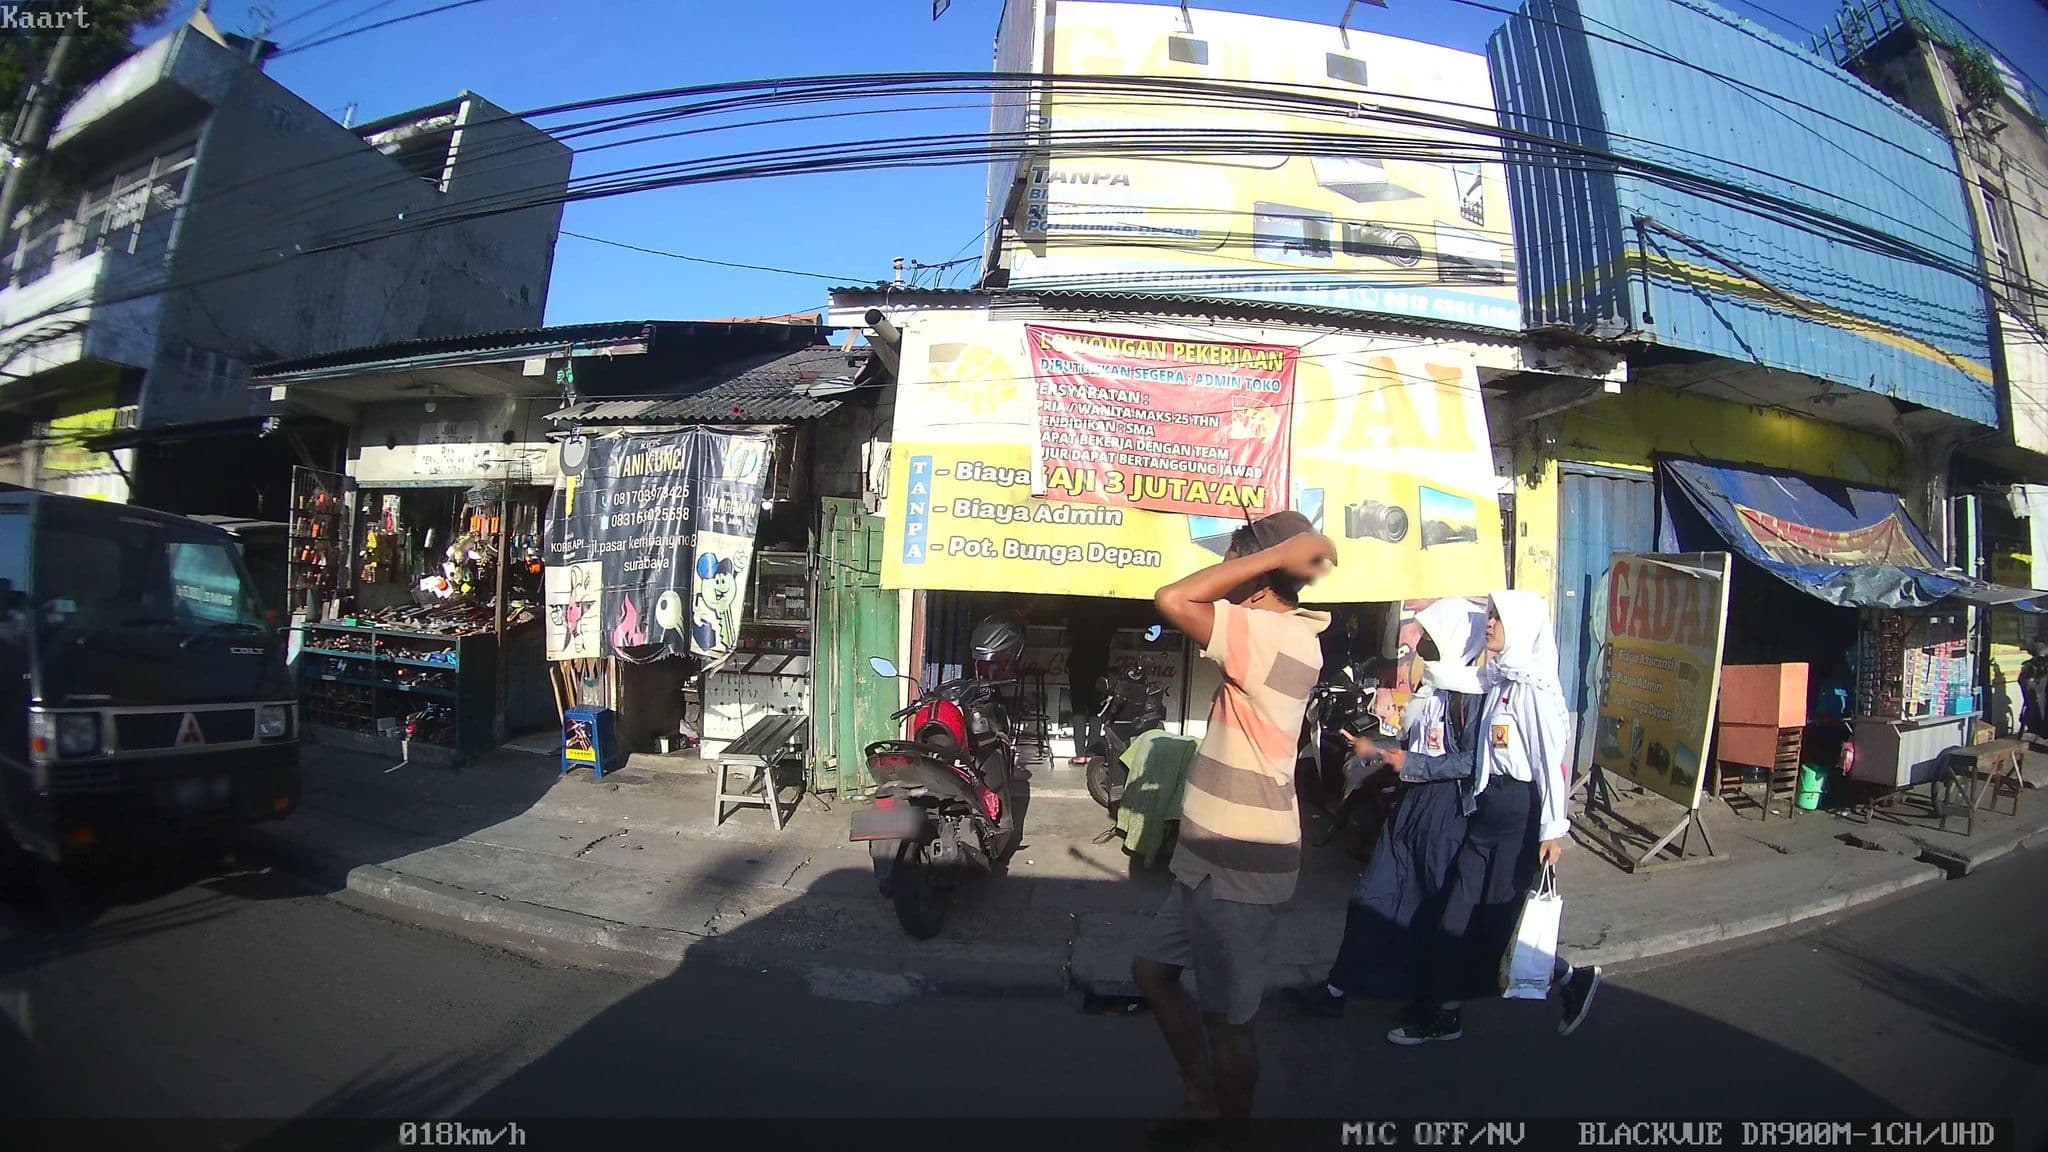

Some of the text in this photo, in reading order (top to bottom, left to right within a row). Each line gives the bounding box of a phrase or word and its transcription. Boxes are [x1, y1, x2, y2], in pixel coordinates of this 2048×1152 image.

[1030, 166, 1131, 187] TANPA
[1172, 343, 1284, 372] PEKERJAAN
[1037, 381, 1141, 404] ERSYARATAN
[1134, 366, 1184, 385] SEGERA
[1195, 372, 1241, 389] ADMIN
[1244, 377, 1281, 393] TOKO
[1038, 399, 1066, 414] RIA
[1078, 402, 1131, 419] WANITA
[1134, 408, 1173, 422] MAKS
[1175, 413, 1189, 424] 25
[1191, 415, 1220, 428] THN
[1040, 415, 1116, 432] ENDIDIKAN
[1126, 423, 1156, 437] SMA
[1041, 431, 1230, 460] APAT BEKERJA DENGAN TEAM
[955, 461, 1031, 487] Biaya
[1071, 449, 1117, 463] DAPAT
[1118, 453, 1217, 475] BERTANGGUNG
[1043, 465, 1266, 508] AJI 3 JUTA'AN
[905, 461, 928, 558] TANPA
[952, 498, 1031, 524] Biaya
[1033, 504, 1123, 526] Admin
[623, 556, 670, 573] surabaya
[948, 535, 998, 558] Pot.
[1003, 538, 1083, 565] Bunga
[1087, 542, 1161, 568] Depan
[230, 647, 265, 655] COLT
